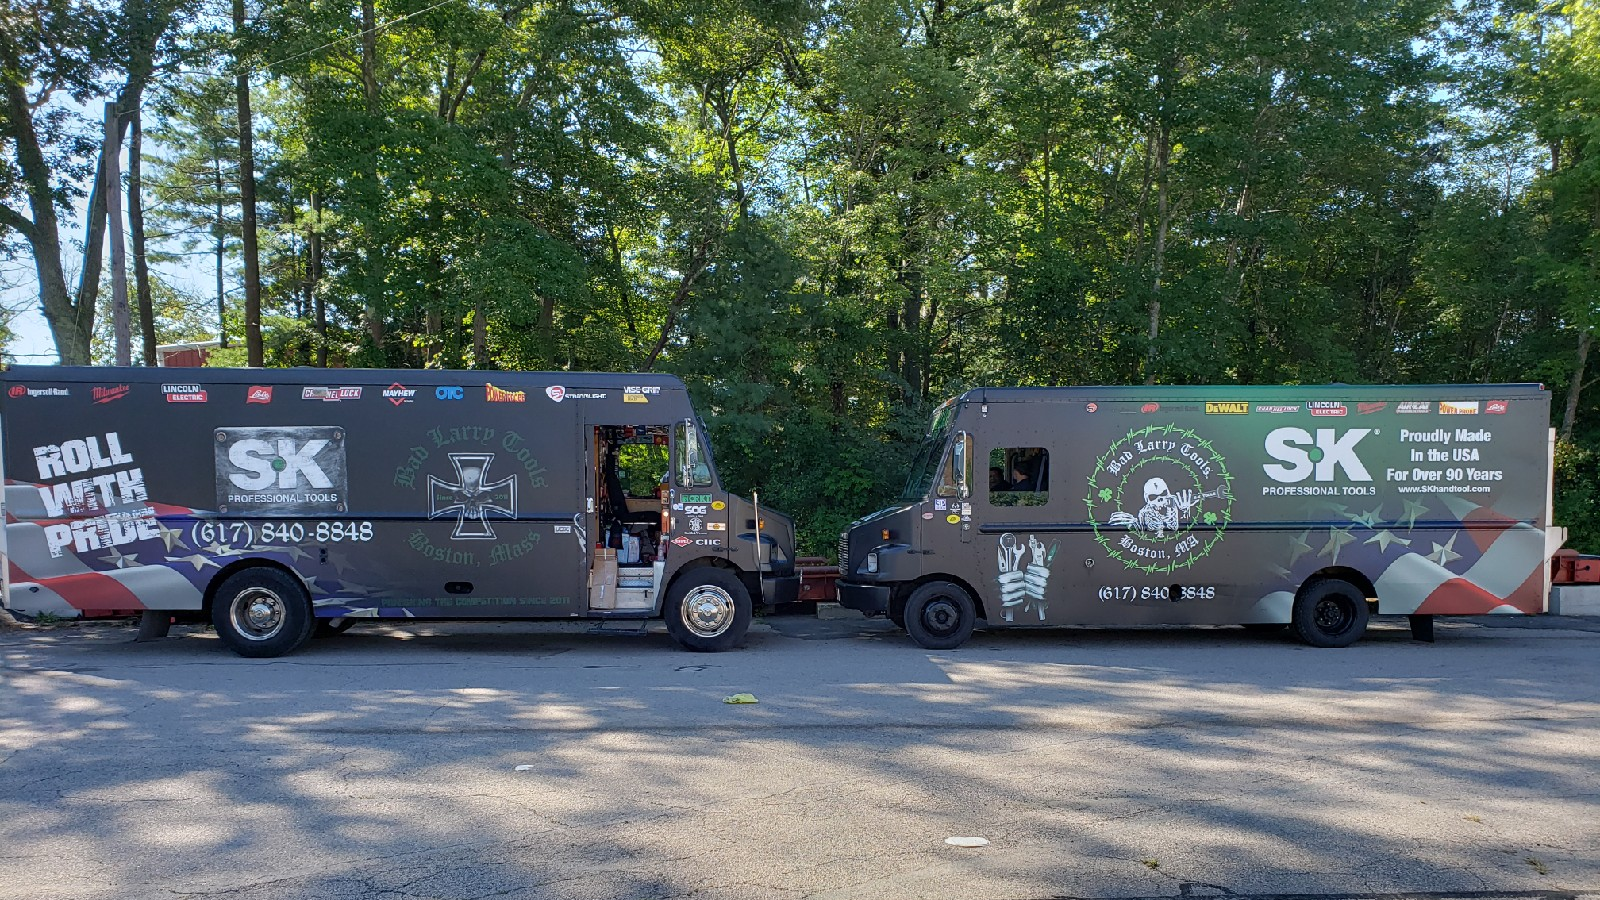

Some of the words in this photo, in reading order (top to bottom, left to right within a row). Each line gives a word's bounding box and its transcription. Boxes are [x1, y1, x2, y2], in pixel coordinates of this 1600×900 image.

[91, 384, 130, 399] Milwaukee
[163, 385, 199, 393] LINCOLN
[382, 389, 415, 397] MAYHEW
[435, 386, 464, 400] OTC
[1307, 401, 1340, 409] LINCOLN
[1400, 428, 1452, 445] Proudly
[1455, 428, 1492, 442] Made
[32, 432, 134, 480] ROLL
[394, 444, 430, 490] Bad
[427, 424, 496, 449] Larry
[502, 430, 549, 488] Tools
[1106, 451, 1133, 477] Bad
[1134, 439, 1176, 454] Larry
[1180, 442, 1213, 479] Tools
[1262, 427, 1374, 483] SK
[1410, 448, 1424, 462] In
[1427, 448, 1449, 462] the
[1452, 448, 1480, 462] USA
[228, 438, 335, 491] SK
[1386, 468, 1409, 482] For
[1412, 467, 1442, 482] Over
[1446, 467, 1463, 482] 90
[1466, 467, 1503, 482] Years
[38, 467, 149, 518] WITH
[1262, 486, 1341, 496] PROFESSIONAL
[1342, 486, 1376, 496] TOOLS
[1398, 485, 1491, 493] www.SKhandtool.com
[228, 493, 302, 503] PROFESSIONAL
[304, 493, 338, 503] TOOLS
[684, 505, 707, 515] SOG
[43, 506, 161, 559] PRIDE
[191, 520, 254, 548] (617)
[407, 528, 481, 568] Boston,
[489, 528, 542, 567] Mass
[1117, 534, 1171, 560] Boston,
[1174, 533, 1199, 558] MA
[1098, 585, 1137, 602] (617)
